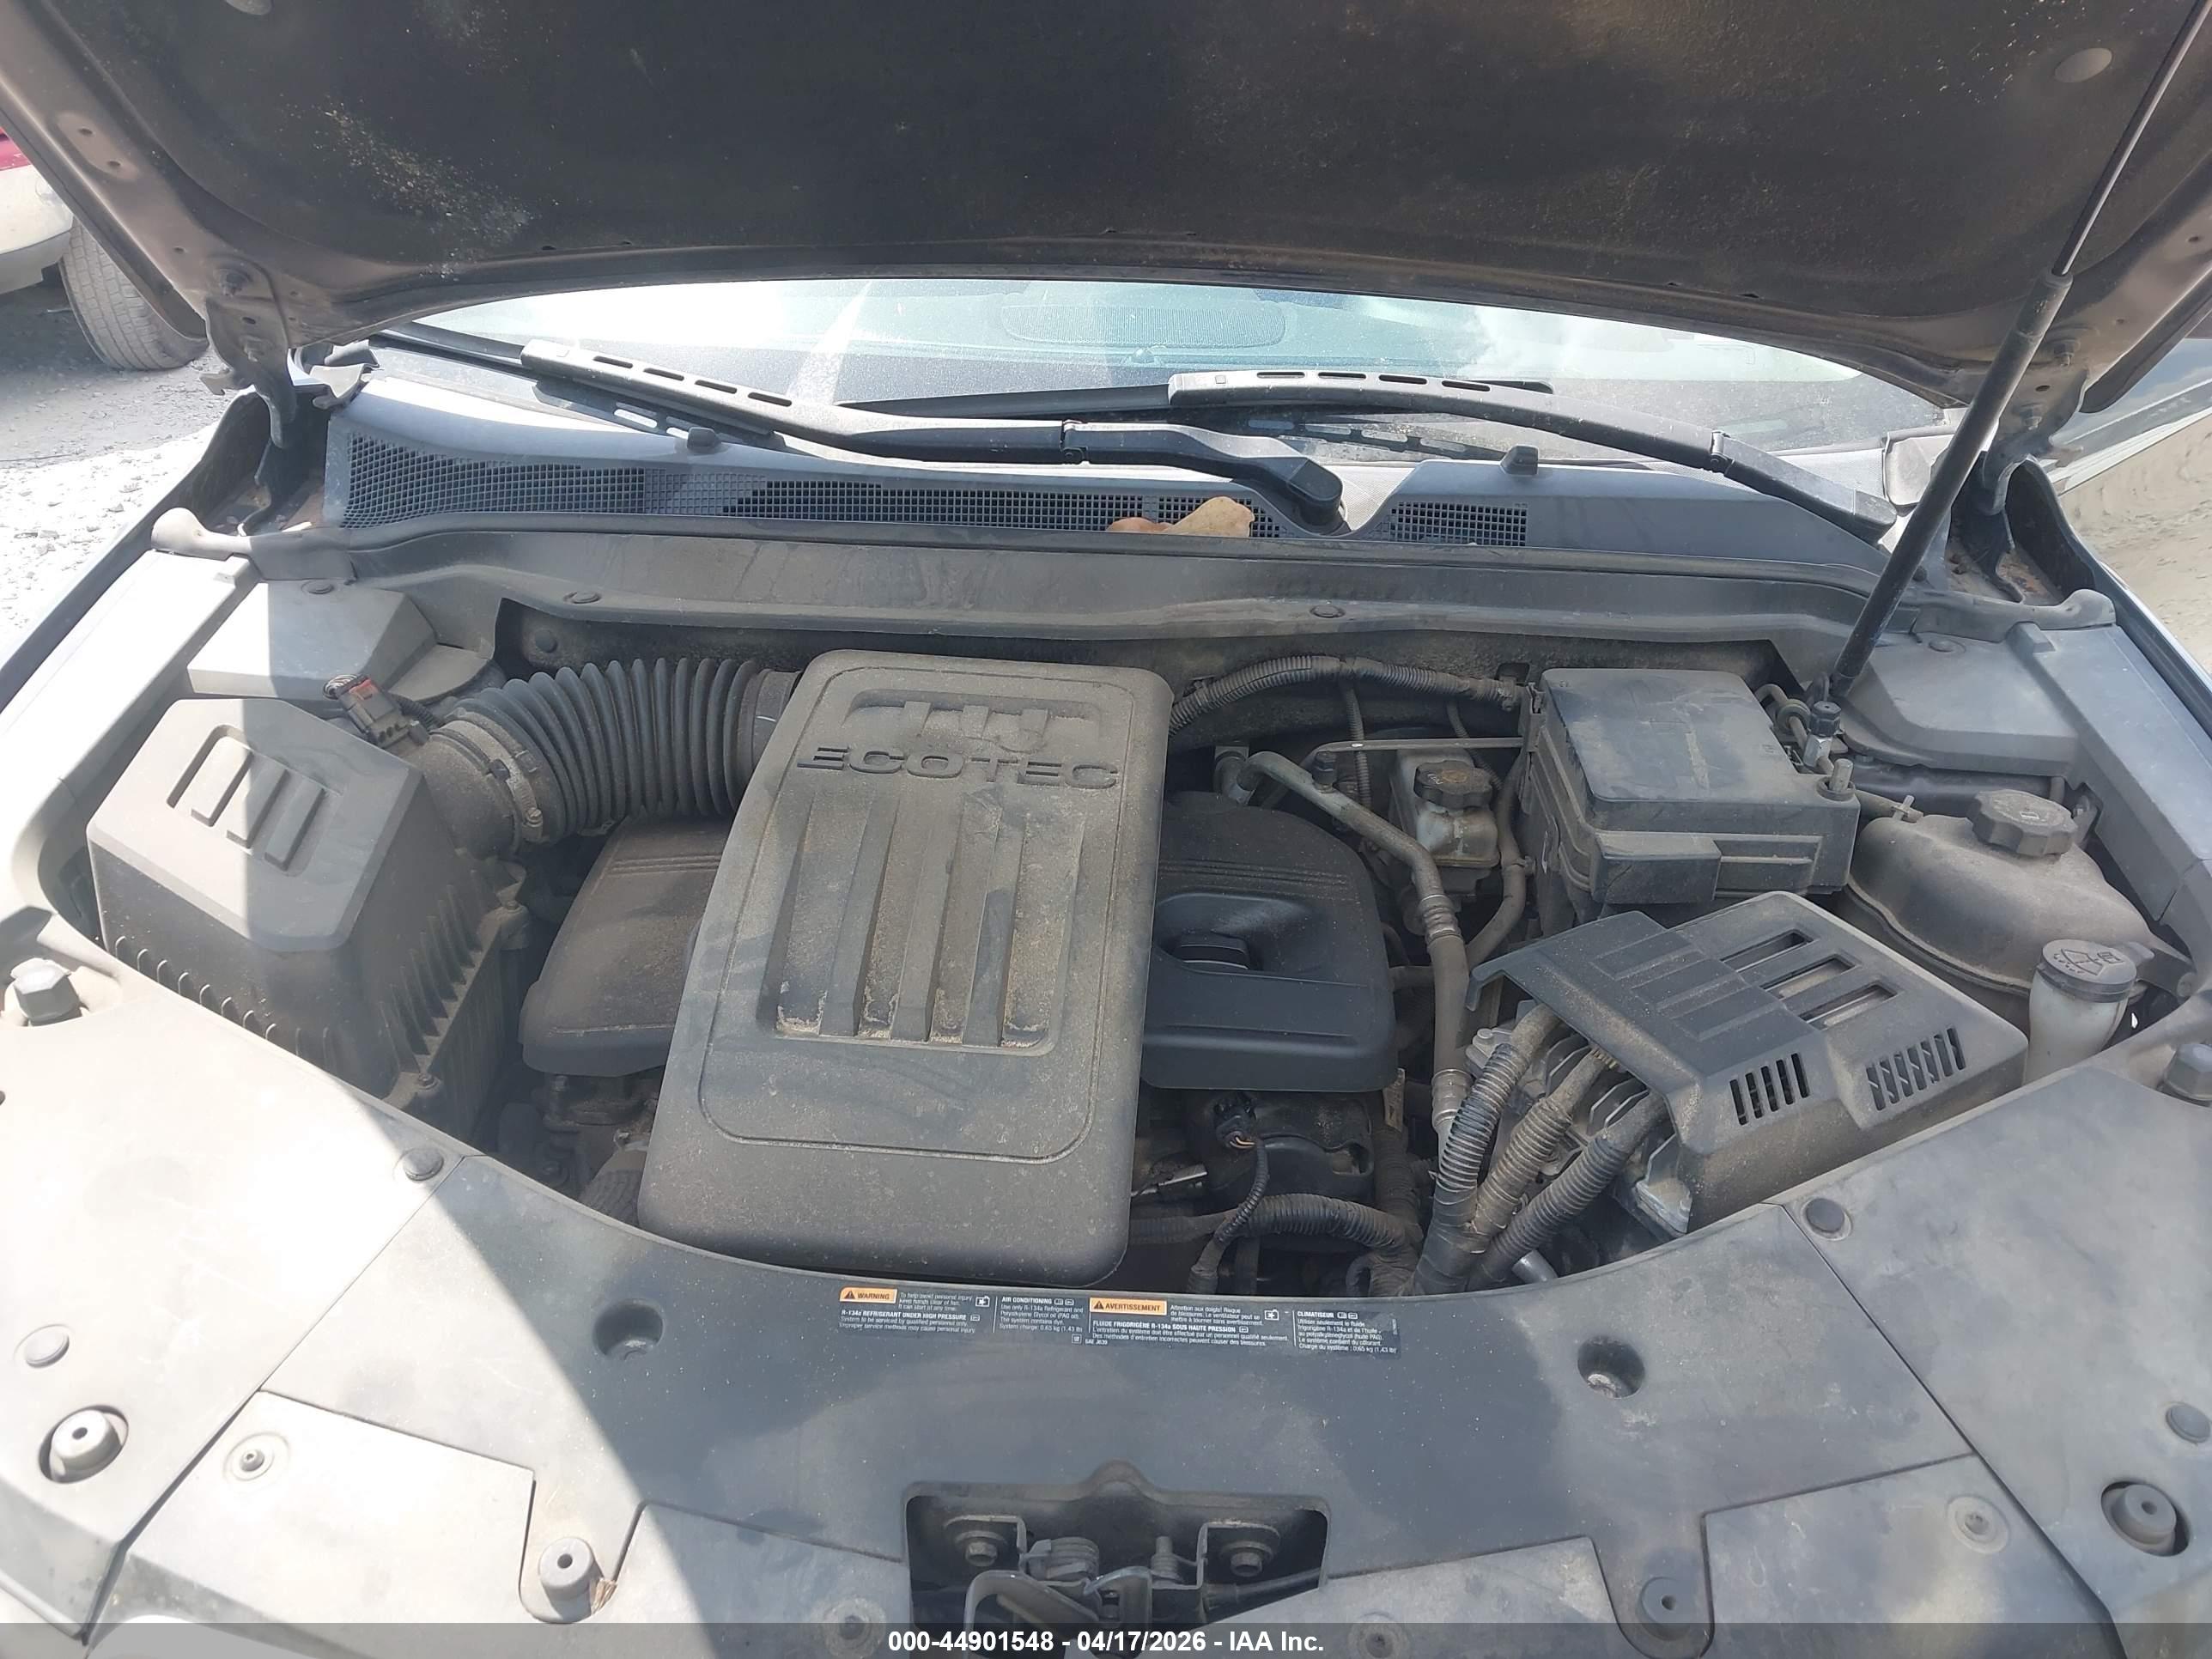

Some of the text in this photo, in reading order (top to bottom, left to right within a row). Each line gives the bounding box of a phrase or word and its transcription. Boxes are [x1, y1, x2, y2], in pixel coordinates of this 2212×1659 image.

[796, 747, 1118, 789] ECOTEC
[858, 1291, 890, 1301] WARNING
[1012, 1297, 1053, 1305] CONDITIONING
[1105, 1303, 1161, 1312] AVERTISSEMENT
[841, 1309, 967, 1322] R-134a REFRIGERANT UNDER HIGH PRESSURE
[1297, 1310, 1334, 1319] CLIMATISEUR
[840, 1316, 860, 1324] System
[1114, 1320, 1151, 1329] FRIGORIGÈNE
[1207, 1325, 1237, 1334] PRESSION
